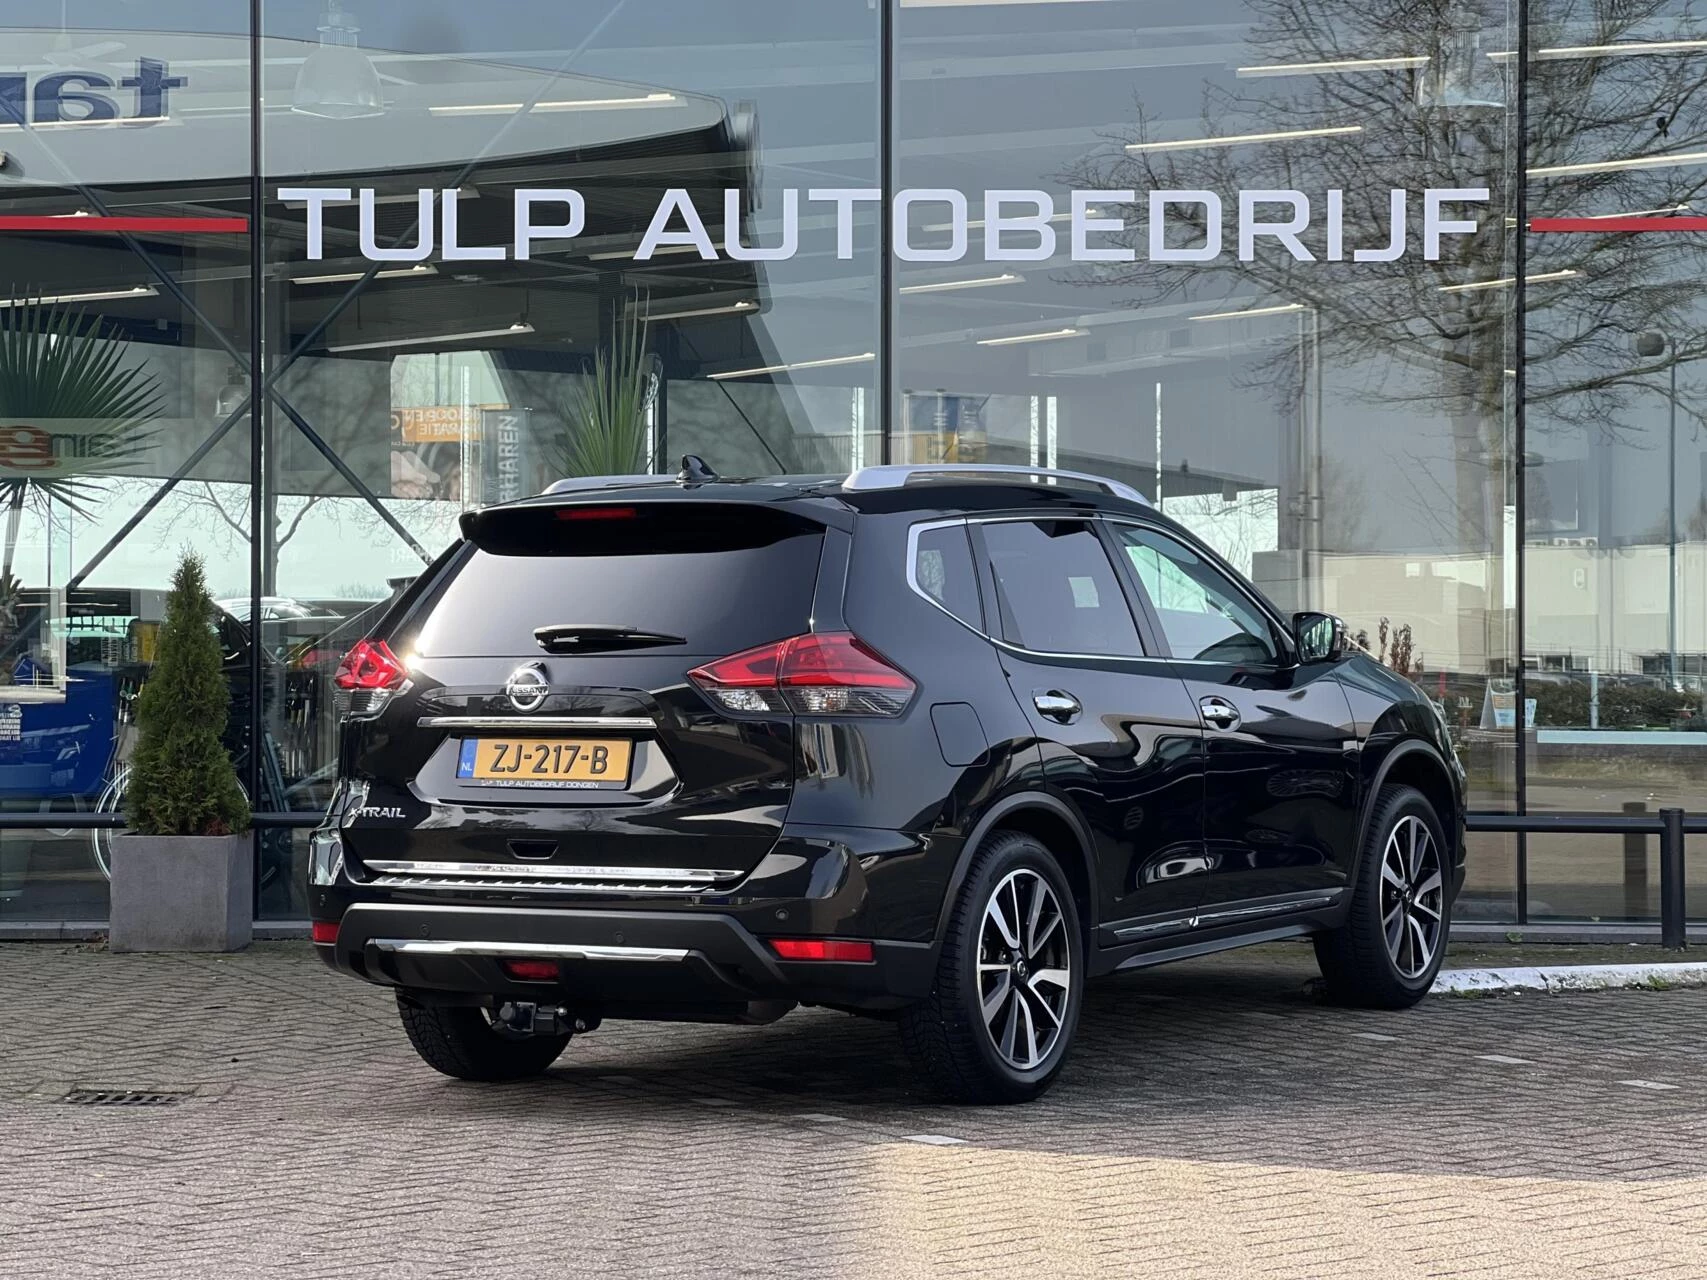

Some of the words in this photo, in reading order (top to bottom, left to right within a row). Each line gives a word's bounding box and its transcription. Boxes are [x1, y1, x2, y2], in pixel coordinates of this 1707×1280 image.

[277, 187, 586, 262] TULP
[633, 187, 1490, 263] AUTOBEDRIJF
[461, 762, 472, 772] NL
[490, 744, 608, 775] ZJ-217-B
[348, 806, 406, 819] X-TRAIL
